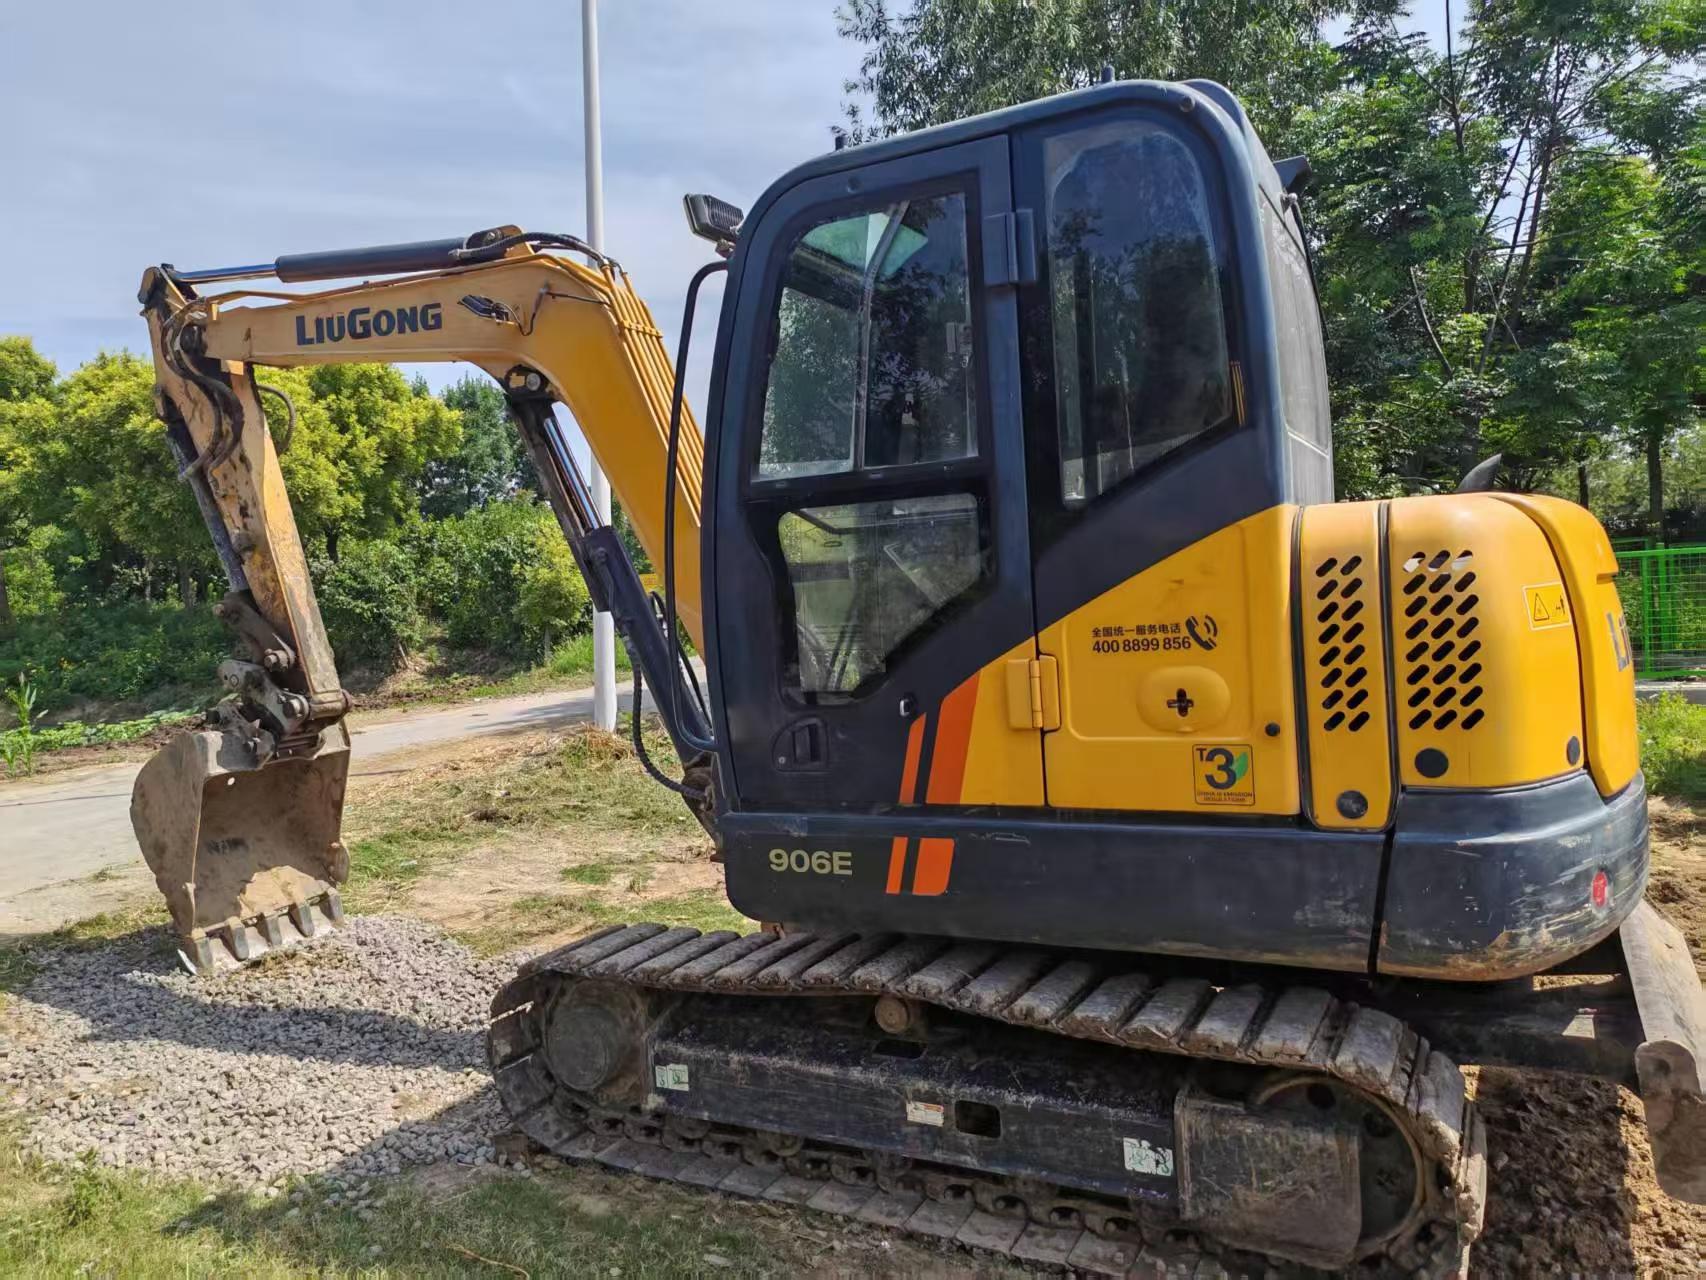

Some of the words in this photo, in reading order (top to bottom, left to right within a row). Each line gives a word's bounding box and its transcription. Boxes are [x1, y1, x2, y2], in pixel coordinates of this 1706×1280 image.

[1091, 623, 1181, 638] 全国统一服务电话
[1092, 639, 1120, 653] 400
[1122, 638, 1160, 652] 8899
[1163, 636, 1191, 651] 856
[768, 848, 853, 875] 906E
